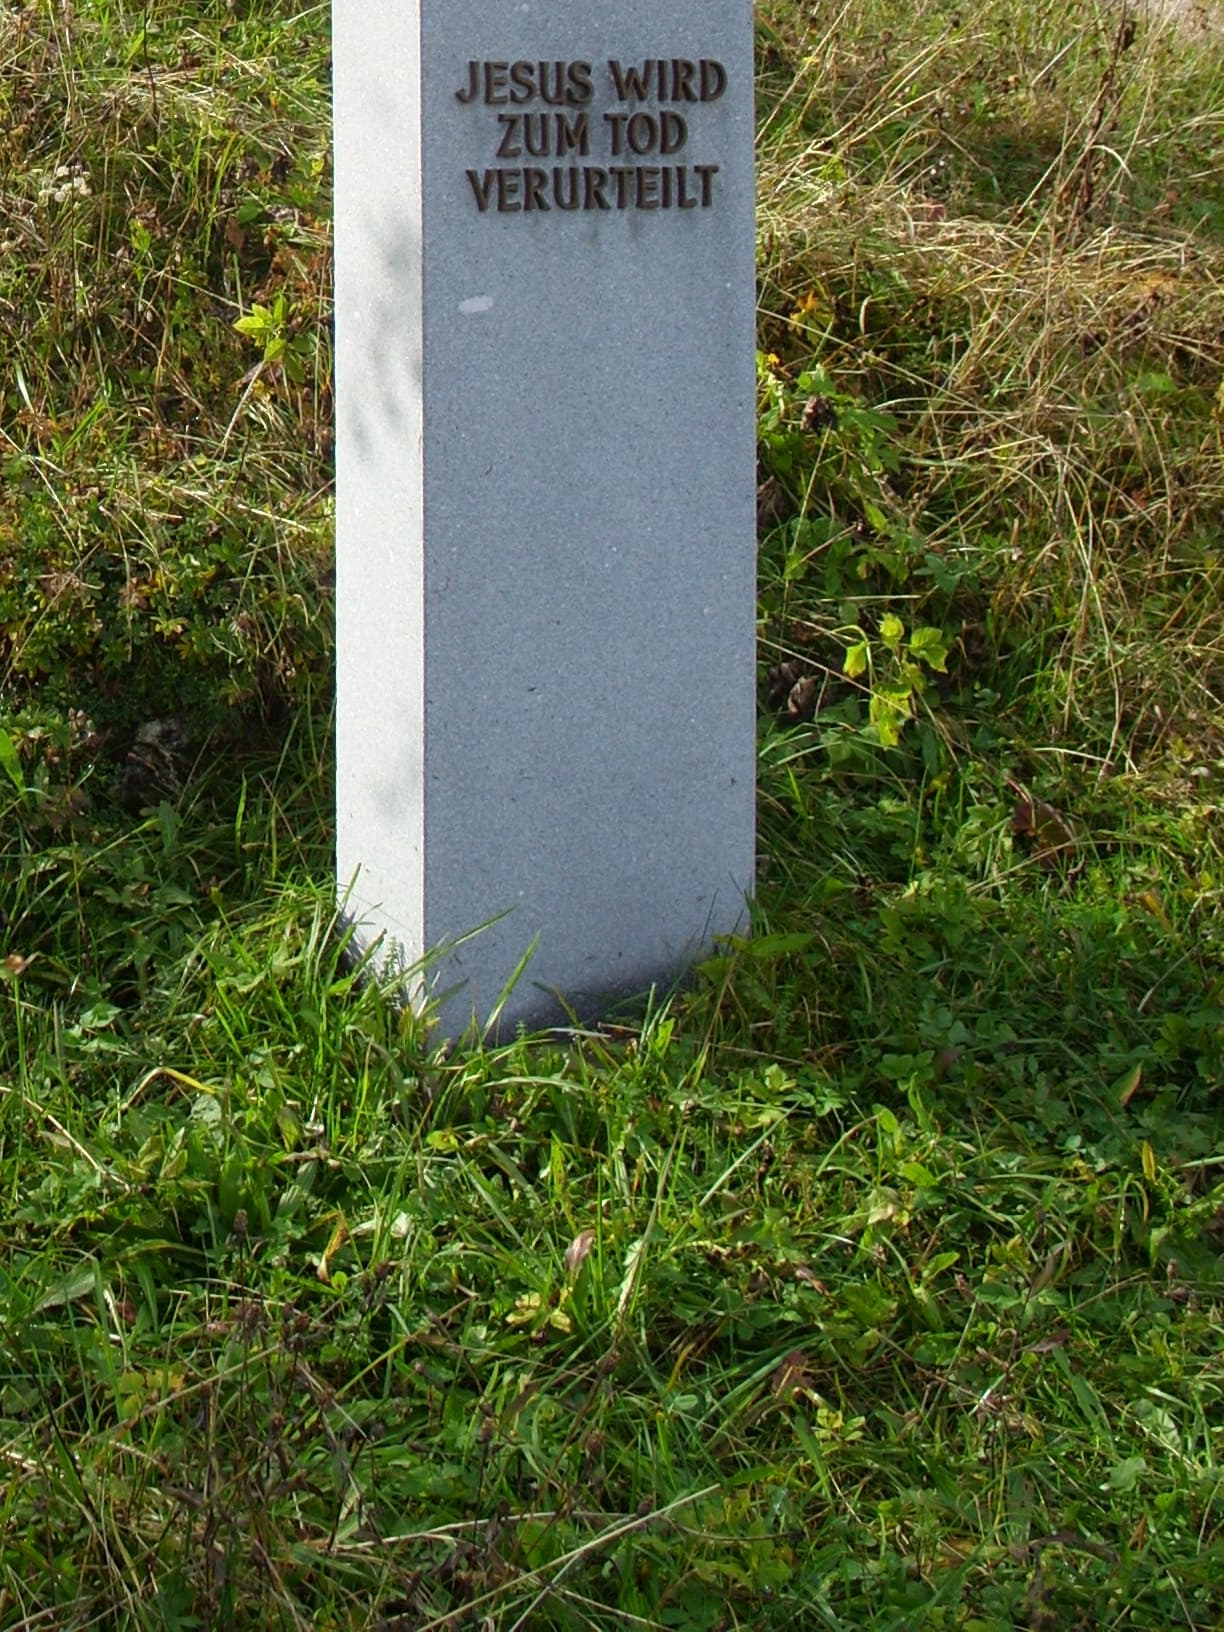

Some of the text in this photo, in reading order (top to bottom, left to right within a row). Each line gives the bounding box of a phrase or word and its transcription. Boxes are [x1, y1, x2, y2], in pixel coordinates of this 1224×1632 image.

[455, 58, 728, 104] JESUS WIRD
[496, 111, 688, 157] ZUM TOD
[465, 165, 720, 212] VERURTEILT
